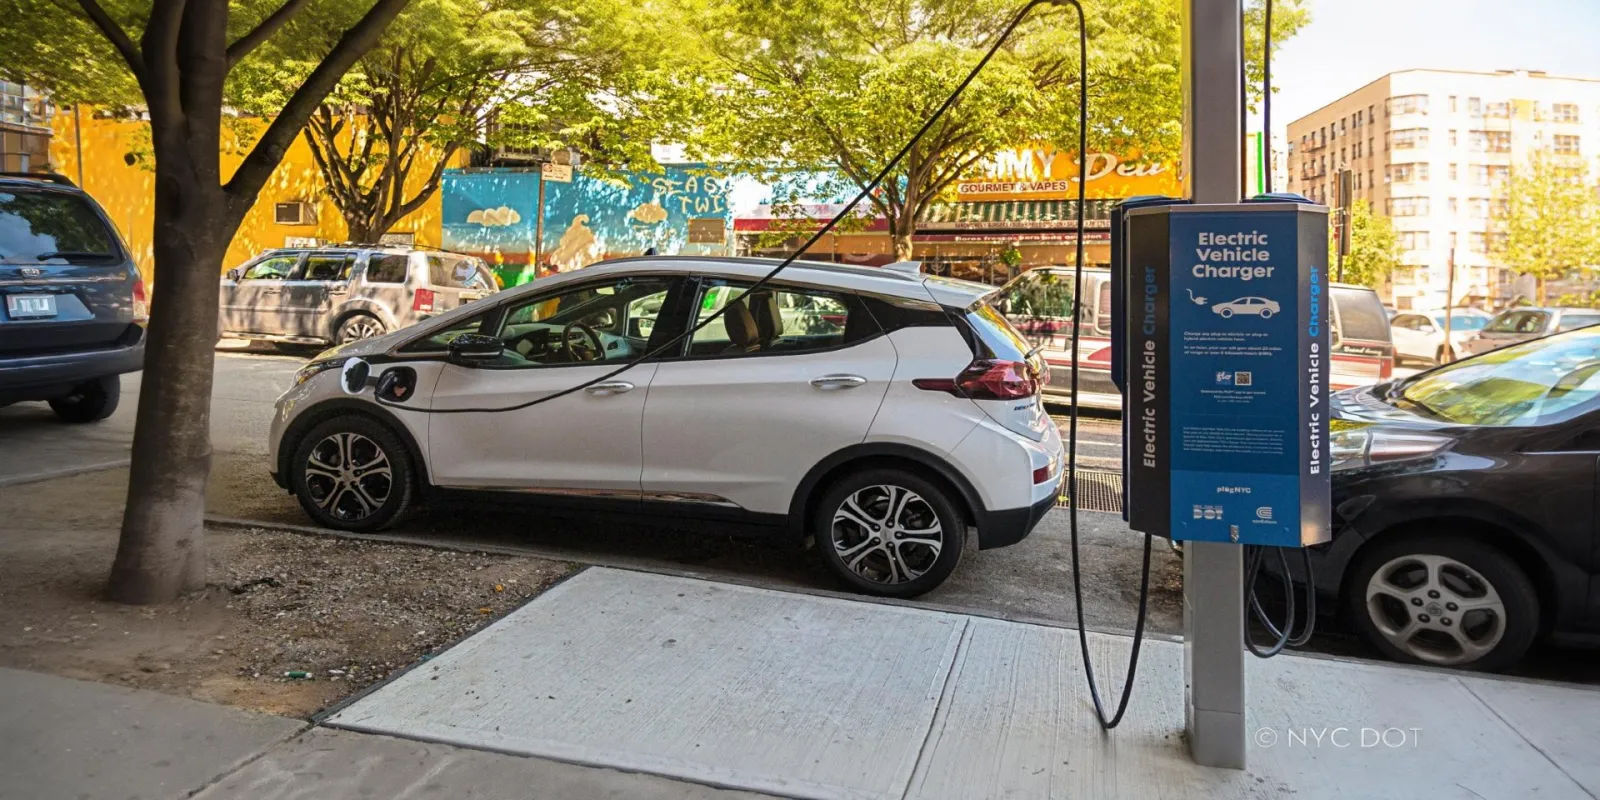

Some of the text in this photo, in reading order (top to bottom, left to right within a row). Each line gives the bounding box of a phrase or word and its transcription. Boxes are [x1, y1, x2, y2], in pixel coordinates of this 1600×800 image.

[961, 182, 1067, 193] GOURMET & VAPES
[1198, 231, 1268, 245] Electric
[1196, 247, 1270, 262] Vehicle
[1192, 265, 1274, 281] Charger
[1142, 266, 1158, 468] Electric Vehicle Charger
[1309, 265, 1321, 475] Electric Vehicle Charger
[1217, 486, 1251, 494] plugNYC
[1193, 508, 1223, 519] DOT
